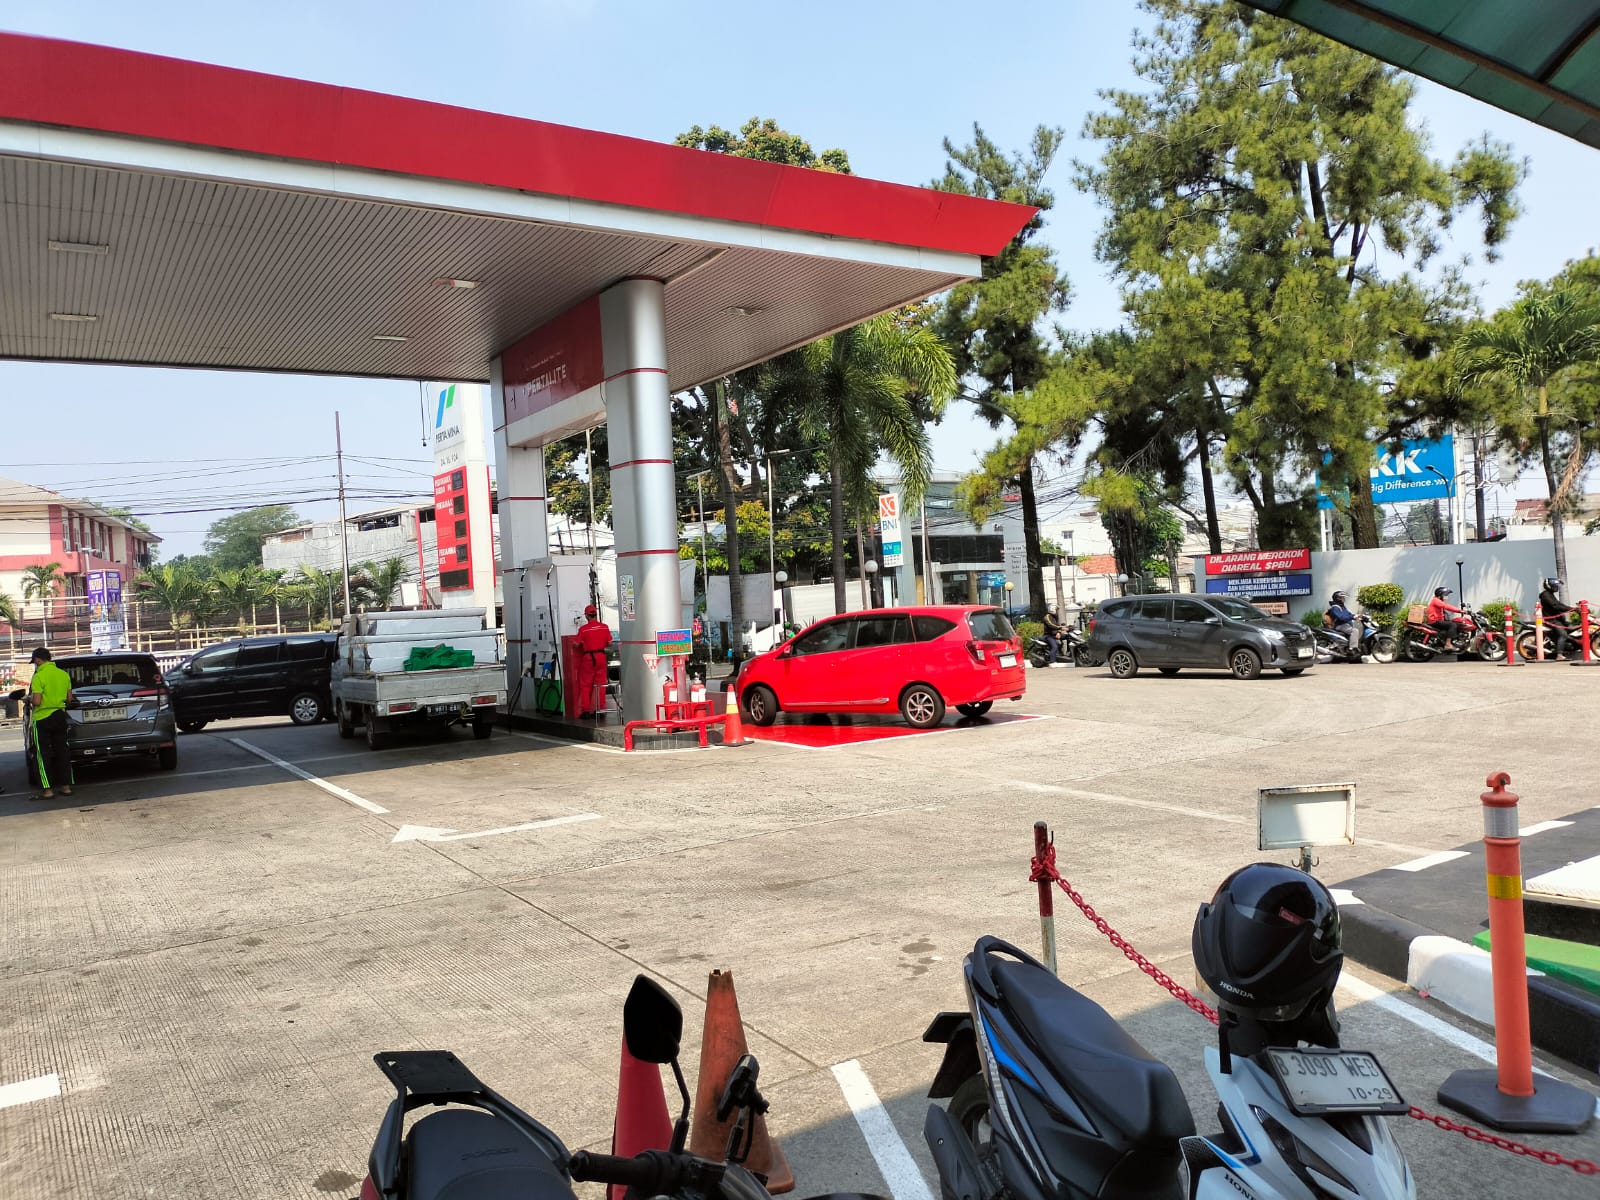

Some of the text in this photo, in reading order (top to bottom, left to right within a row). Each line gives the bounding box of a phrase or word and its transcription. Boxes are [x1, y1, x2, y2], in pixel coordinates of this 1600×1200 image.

[527, 363, 567, 397] PERTALITE
[1385, 479, 1434, 491] Difference.
[882, 519, 898, 531] BNI
[1209, 550, 1304, 564] DILARANG MEROKOK
[1264, 561, 1292, 569] SPBU
[1227, 584, 1238, 592] DAN
[1268, 582, 1288, 590] LOKASI
[1228, 578, 1252, 586] MENJAGA
[1219, 980, 1255, 1000] HONDA
[1272, 1055, 1289, 1076] B
[1291, 1055, 1338, 1077] 3090
